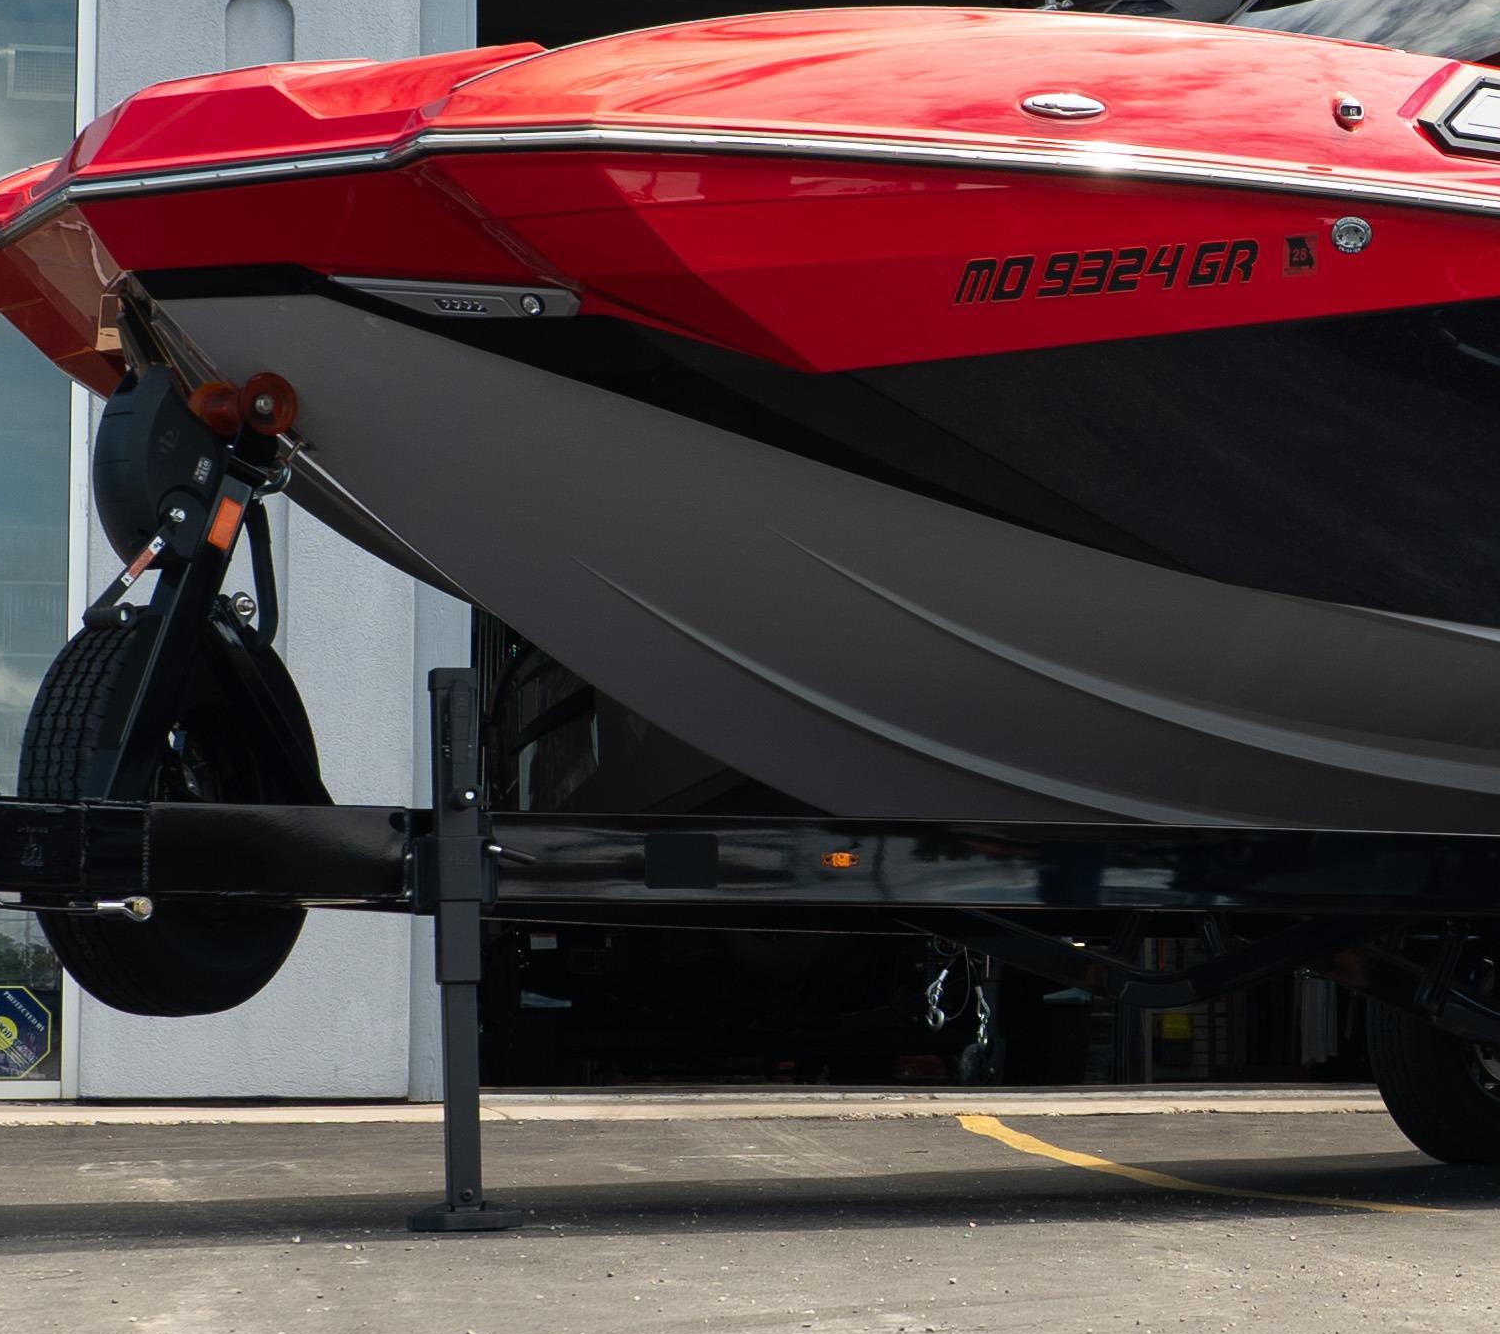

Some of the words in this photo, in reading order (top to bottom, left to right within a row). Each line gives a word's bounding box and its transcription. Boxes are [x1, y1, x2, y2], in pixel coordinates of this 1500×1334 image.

[952, 254, 1035, 305] MO
[1035, 243, 1186, 299] 9324
[1186, 238, 1259, 289] GR
